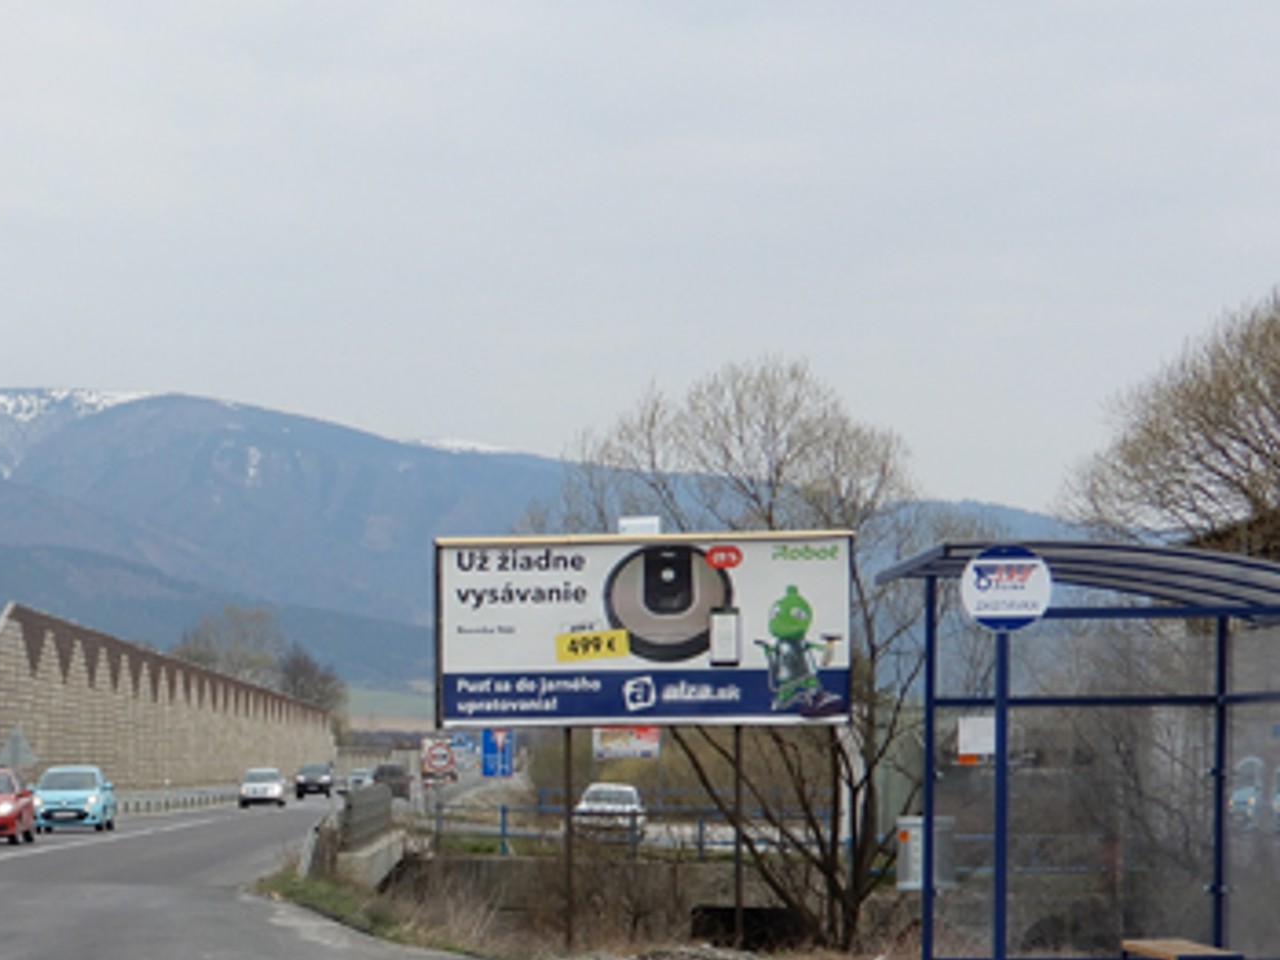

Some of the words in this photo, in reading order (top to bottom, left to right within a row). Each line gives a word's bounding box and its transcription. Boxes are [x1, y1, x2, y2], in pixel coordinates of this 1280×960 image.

[456, 550, 489, 571] Už
[497, 549, 586, 572] žiadne
[456, 580, 587, 610] vysávanie
[566, 636, 602, 655] 499
